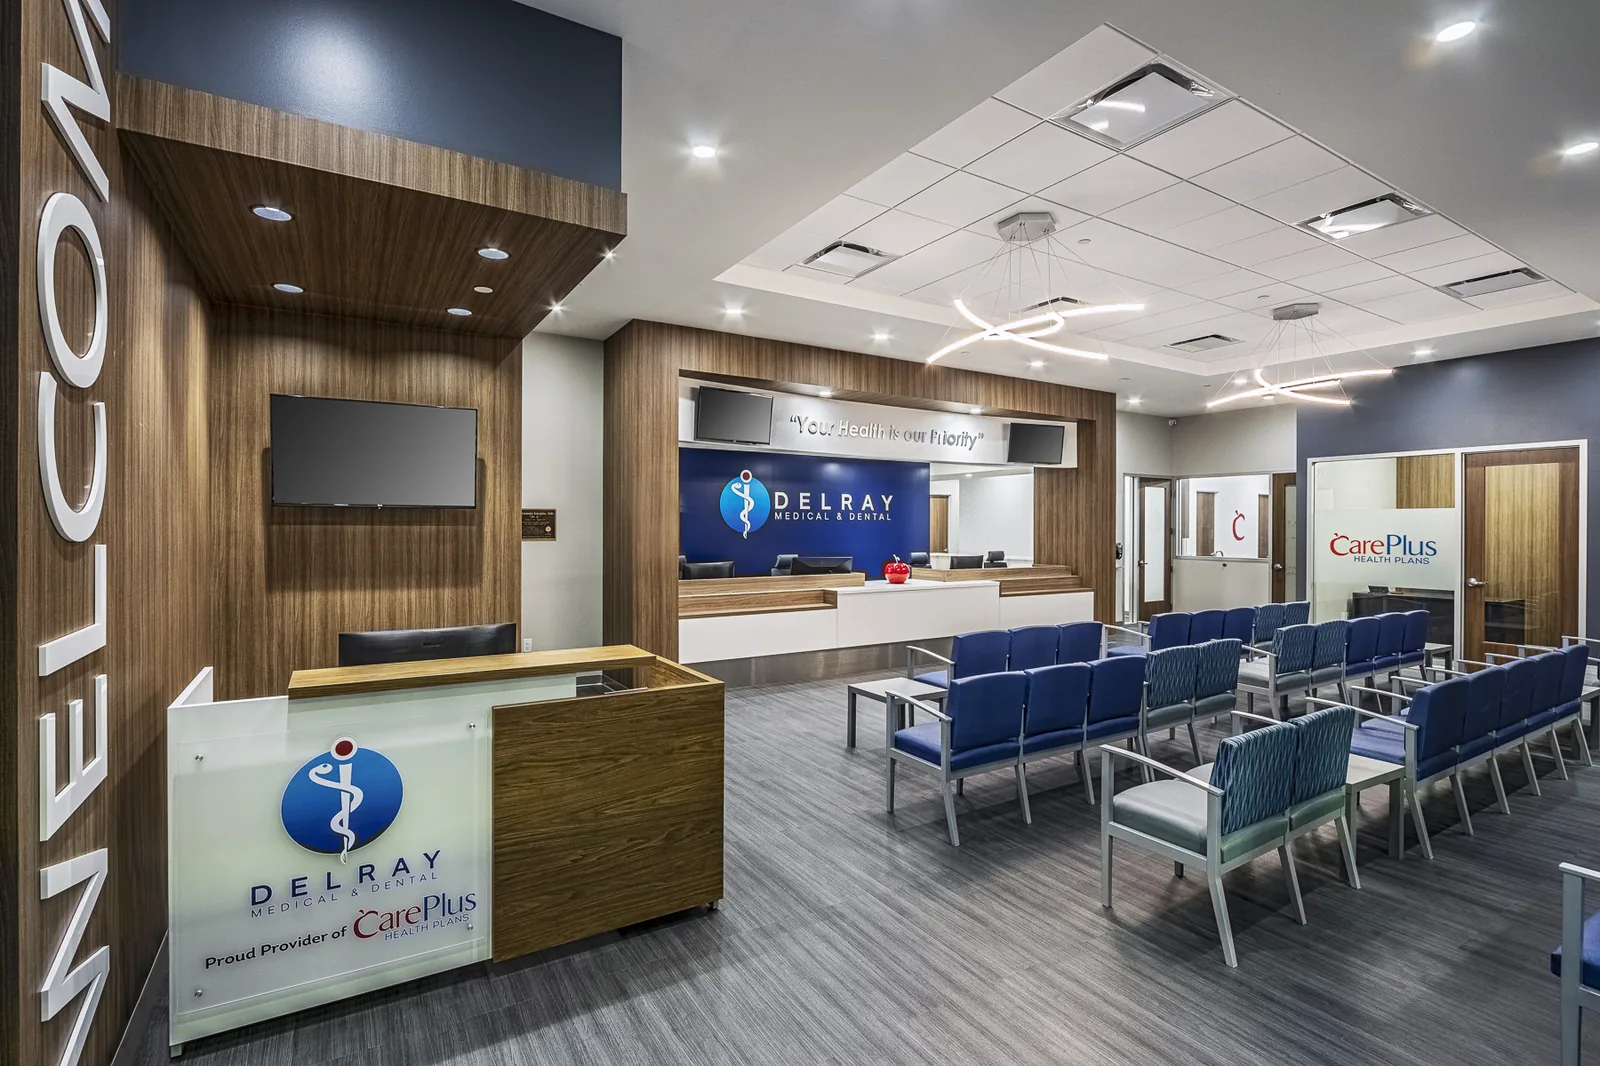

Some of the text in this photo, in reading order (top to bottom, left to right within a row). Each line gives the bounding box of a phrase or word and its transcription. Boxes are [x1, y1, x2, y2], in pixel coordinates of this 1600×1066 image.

[838, 420, 886, 440] Health
[889, 424, 900, 441] is
[903, 429, 927, 443] our
[774, 491, 894, 511] DELRAY
[774, 511, 891, 521] MEDICAL & DENTAL
[1329, 532, 1438, 557] CarePlus
[1353, 556, 1430, 565] HEALTH PLANS
[251, 849, 441, 906] DELRAY
[251, 872, 438, 918] MEDICAL & DENTAL
[205, 892, 477, 970] Proud Provider of CarePlus
[384, 913, 470, 941] HEALTH PLANS
